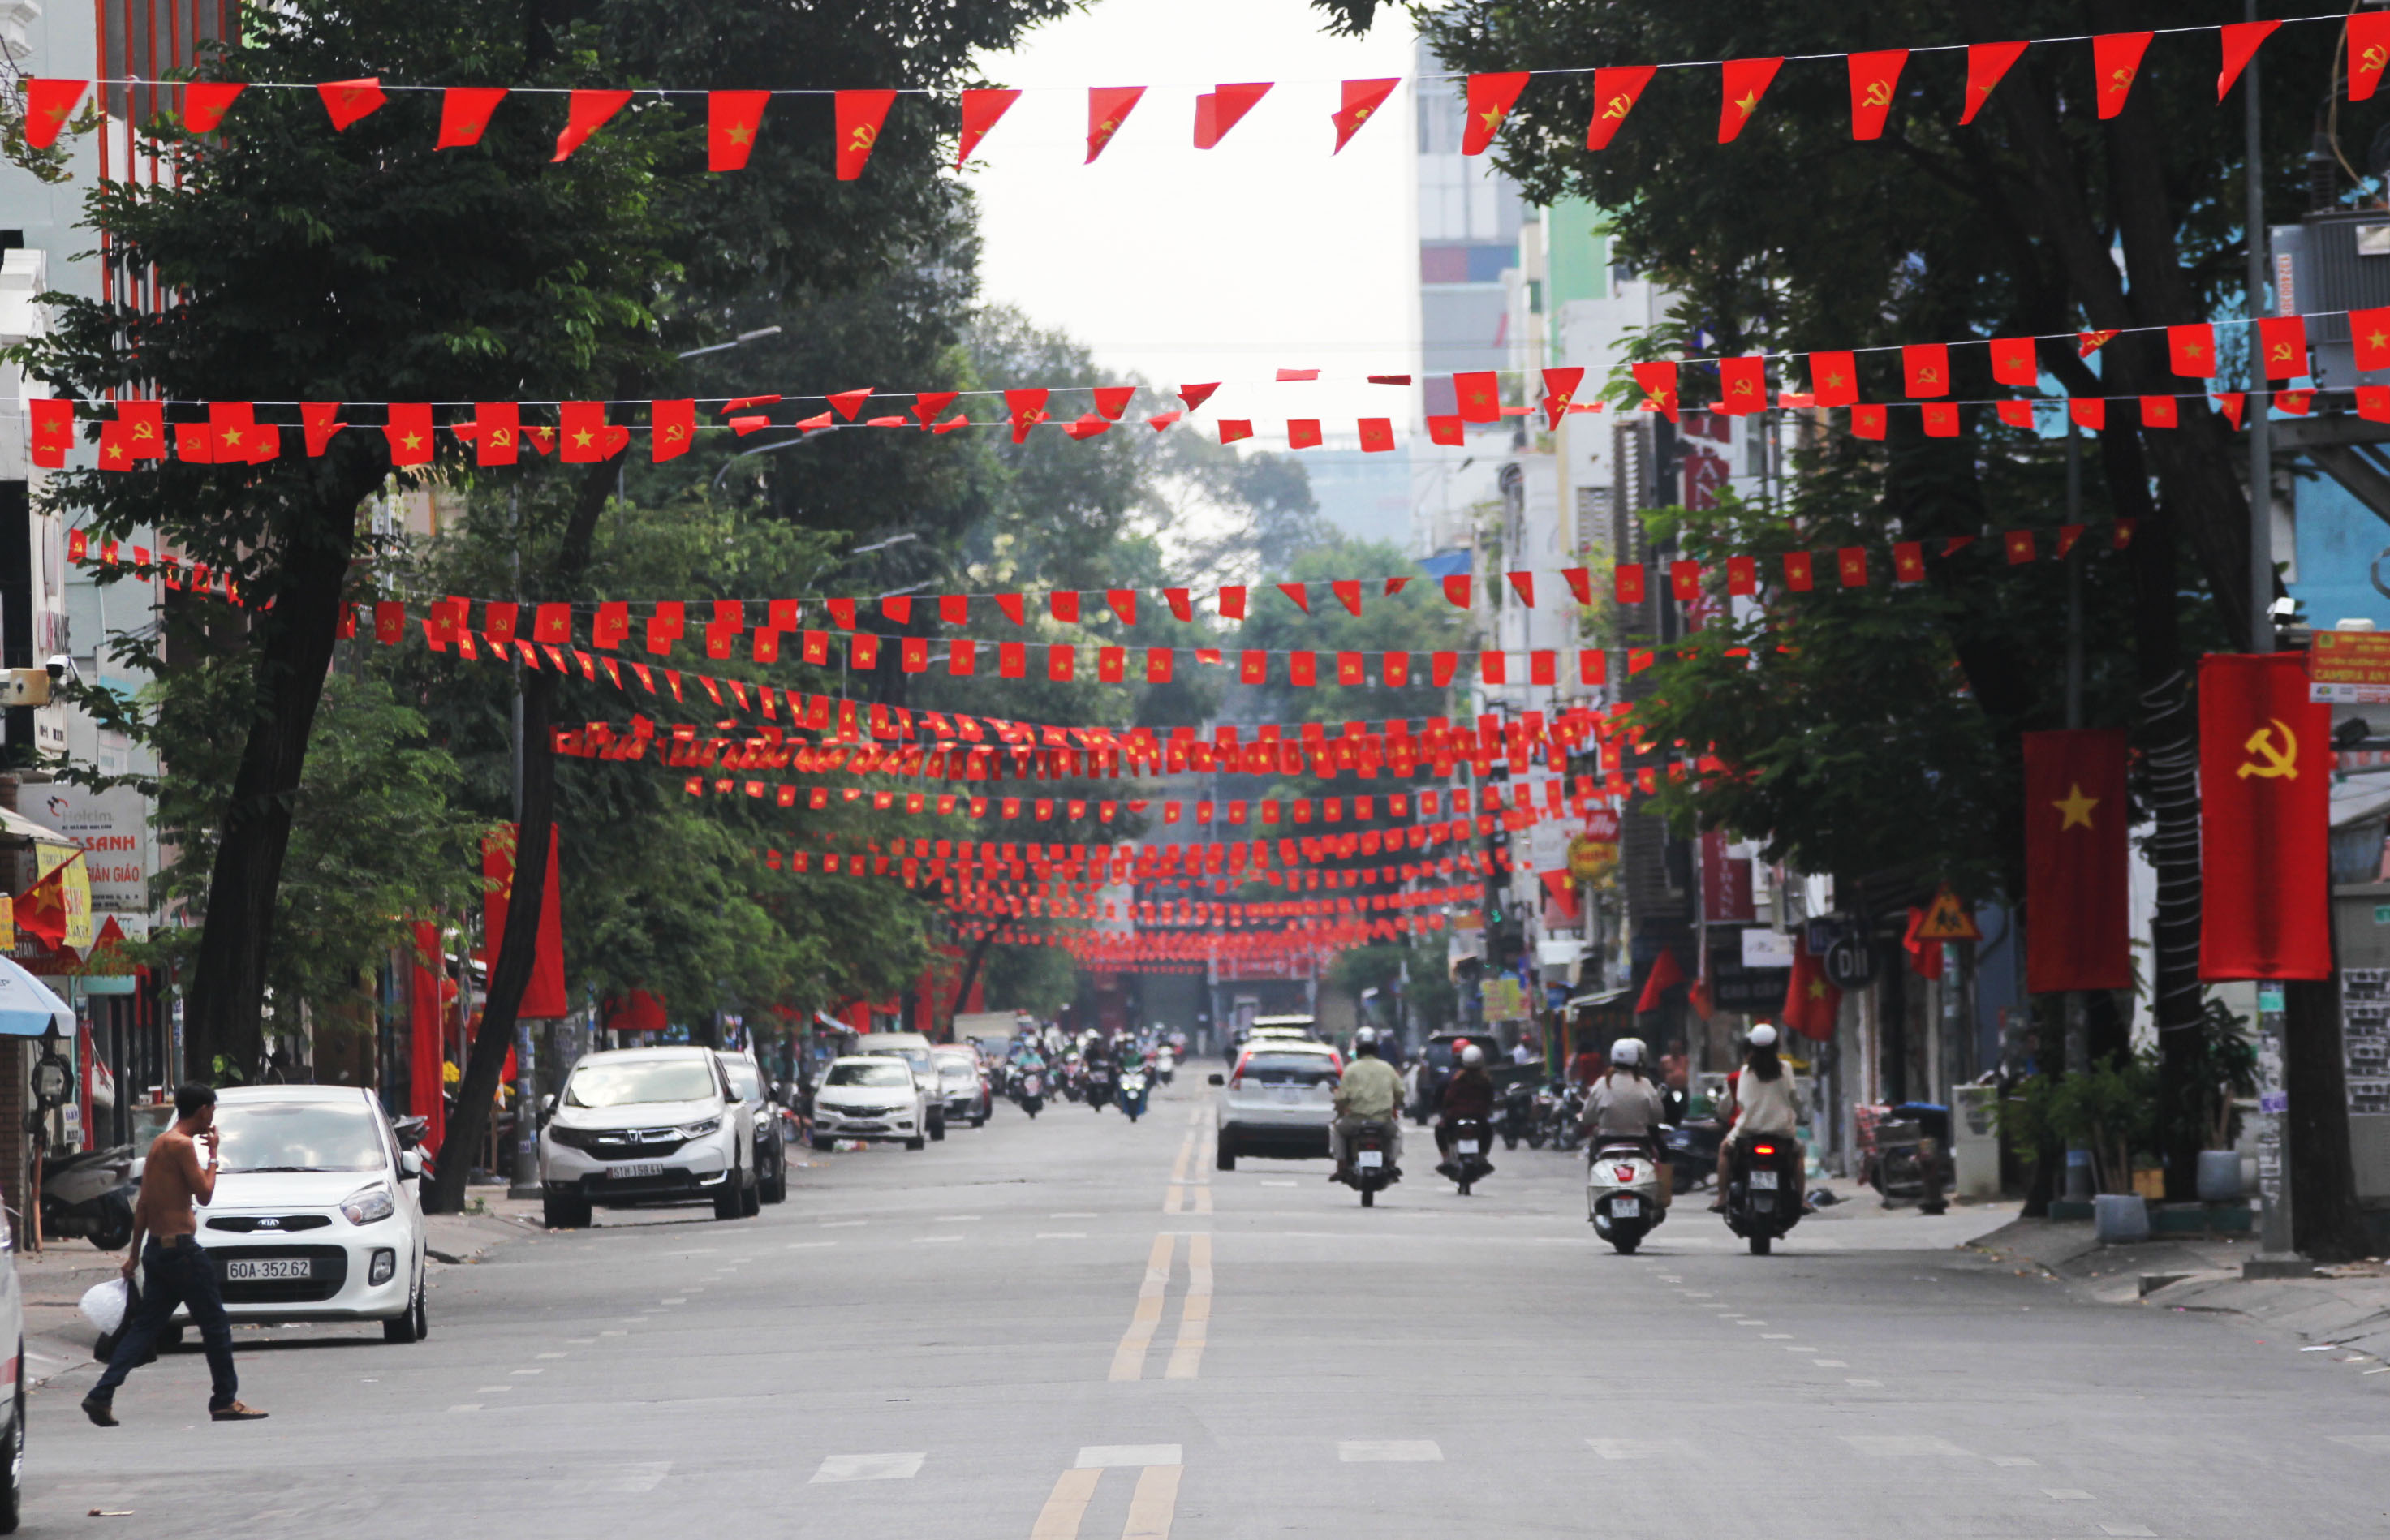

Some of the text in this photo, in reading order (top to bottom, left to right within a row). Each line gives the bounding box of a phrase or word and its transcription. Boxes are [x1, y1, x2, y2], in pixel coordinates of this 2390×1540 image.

[84, 835, 136, 852] SANH
[113, 863, 140, 883] GIÁO
[260, 1219, 277, 1227] KIA
[230, 1261, 308, 1279] 60A-352.62
